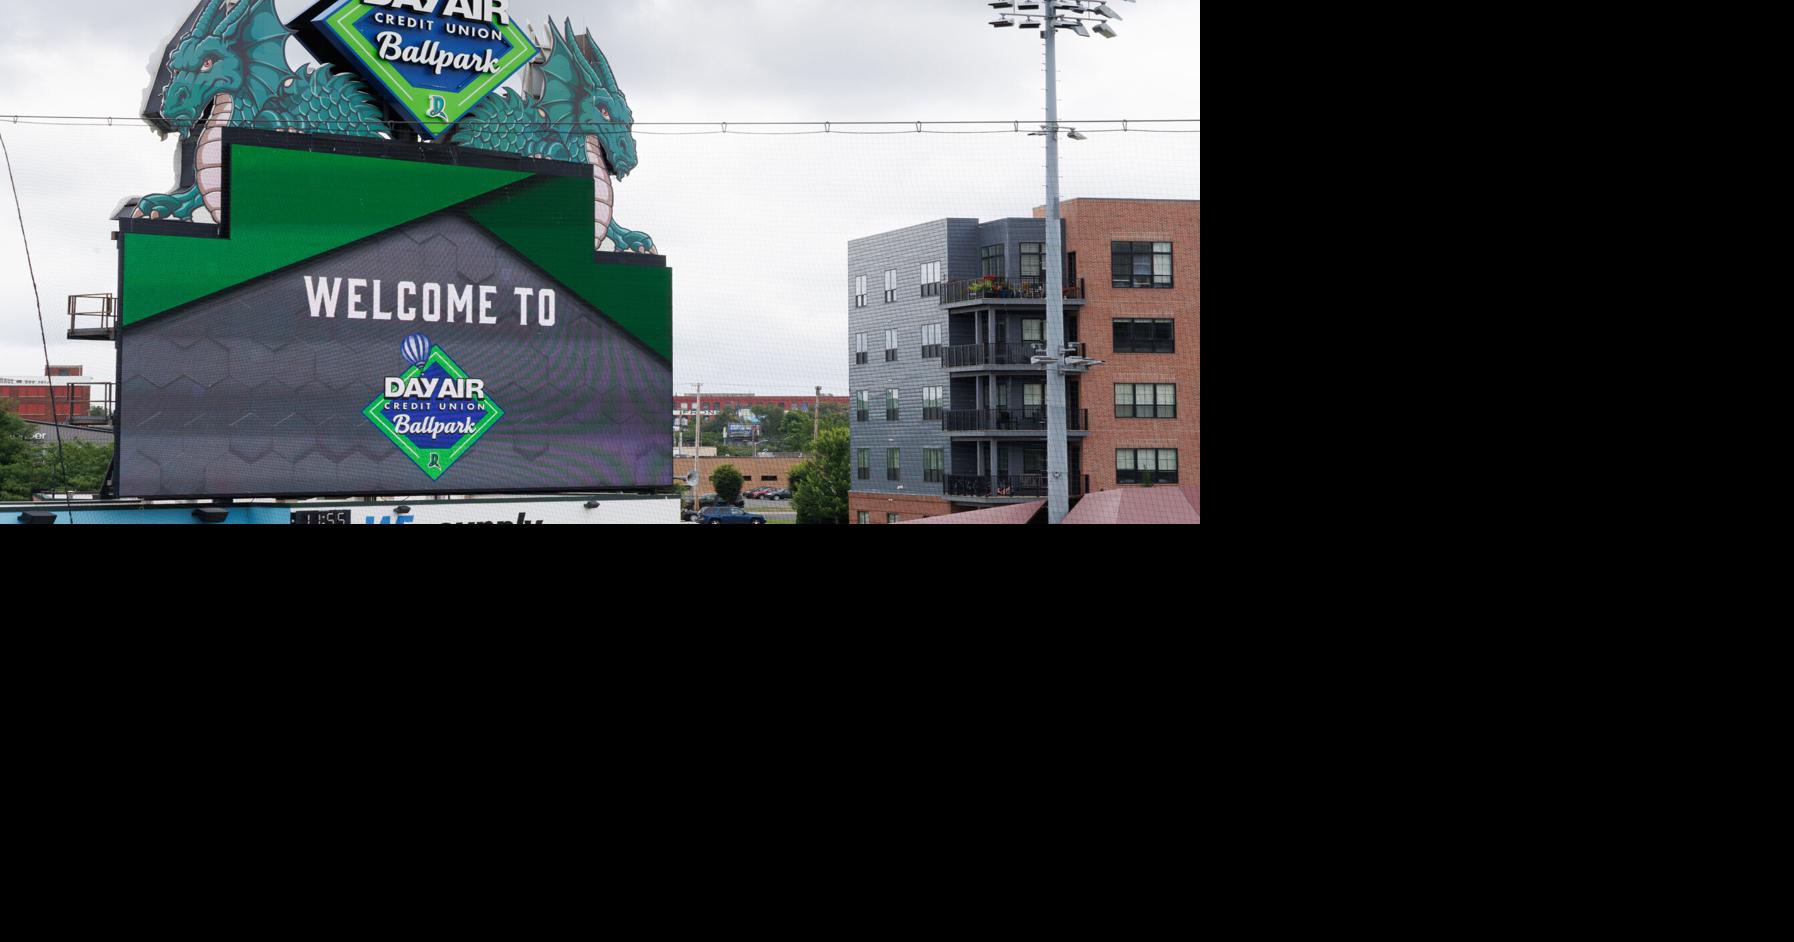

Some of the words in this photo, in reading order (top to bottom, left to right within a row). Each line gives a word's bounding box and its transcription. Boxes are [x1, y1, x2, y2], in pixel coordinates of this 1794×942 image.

[374, 12, 434, 31] CREDIT
[446, 23, 502, 41] UNION
[376, 31, 501, 75] Ballpark
[304, 275, 497, 325] WELCOME
[514, 286, 556, 327] TO
[384, 401, 431, 411] CREDIT
[439, 402, 486, 411] UNION
[392, 414, 477, 439] Ballpark
